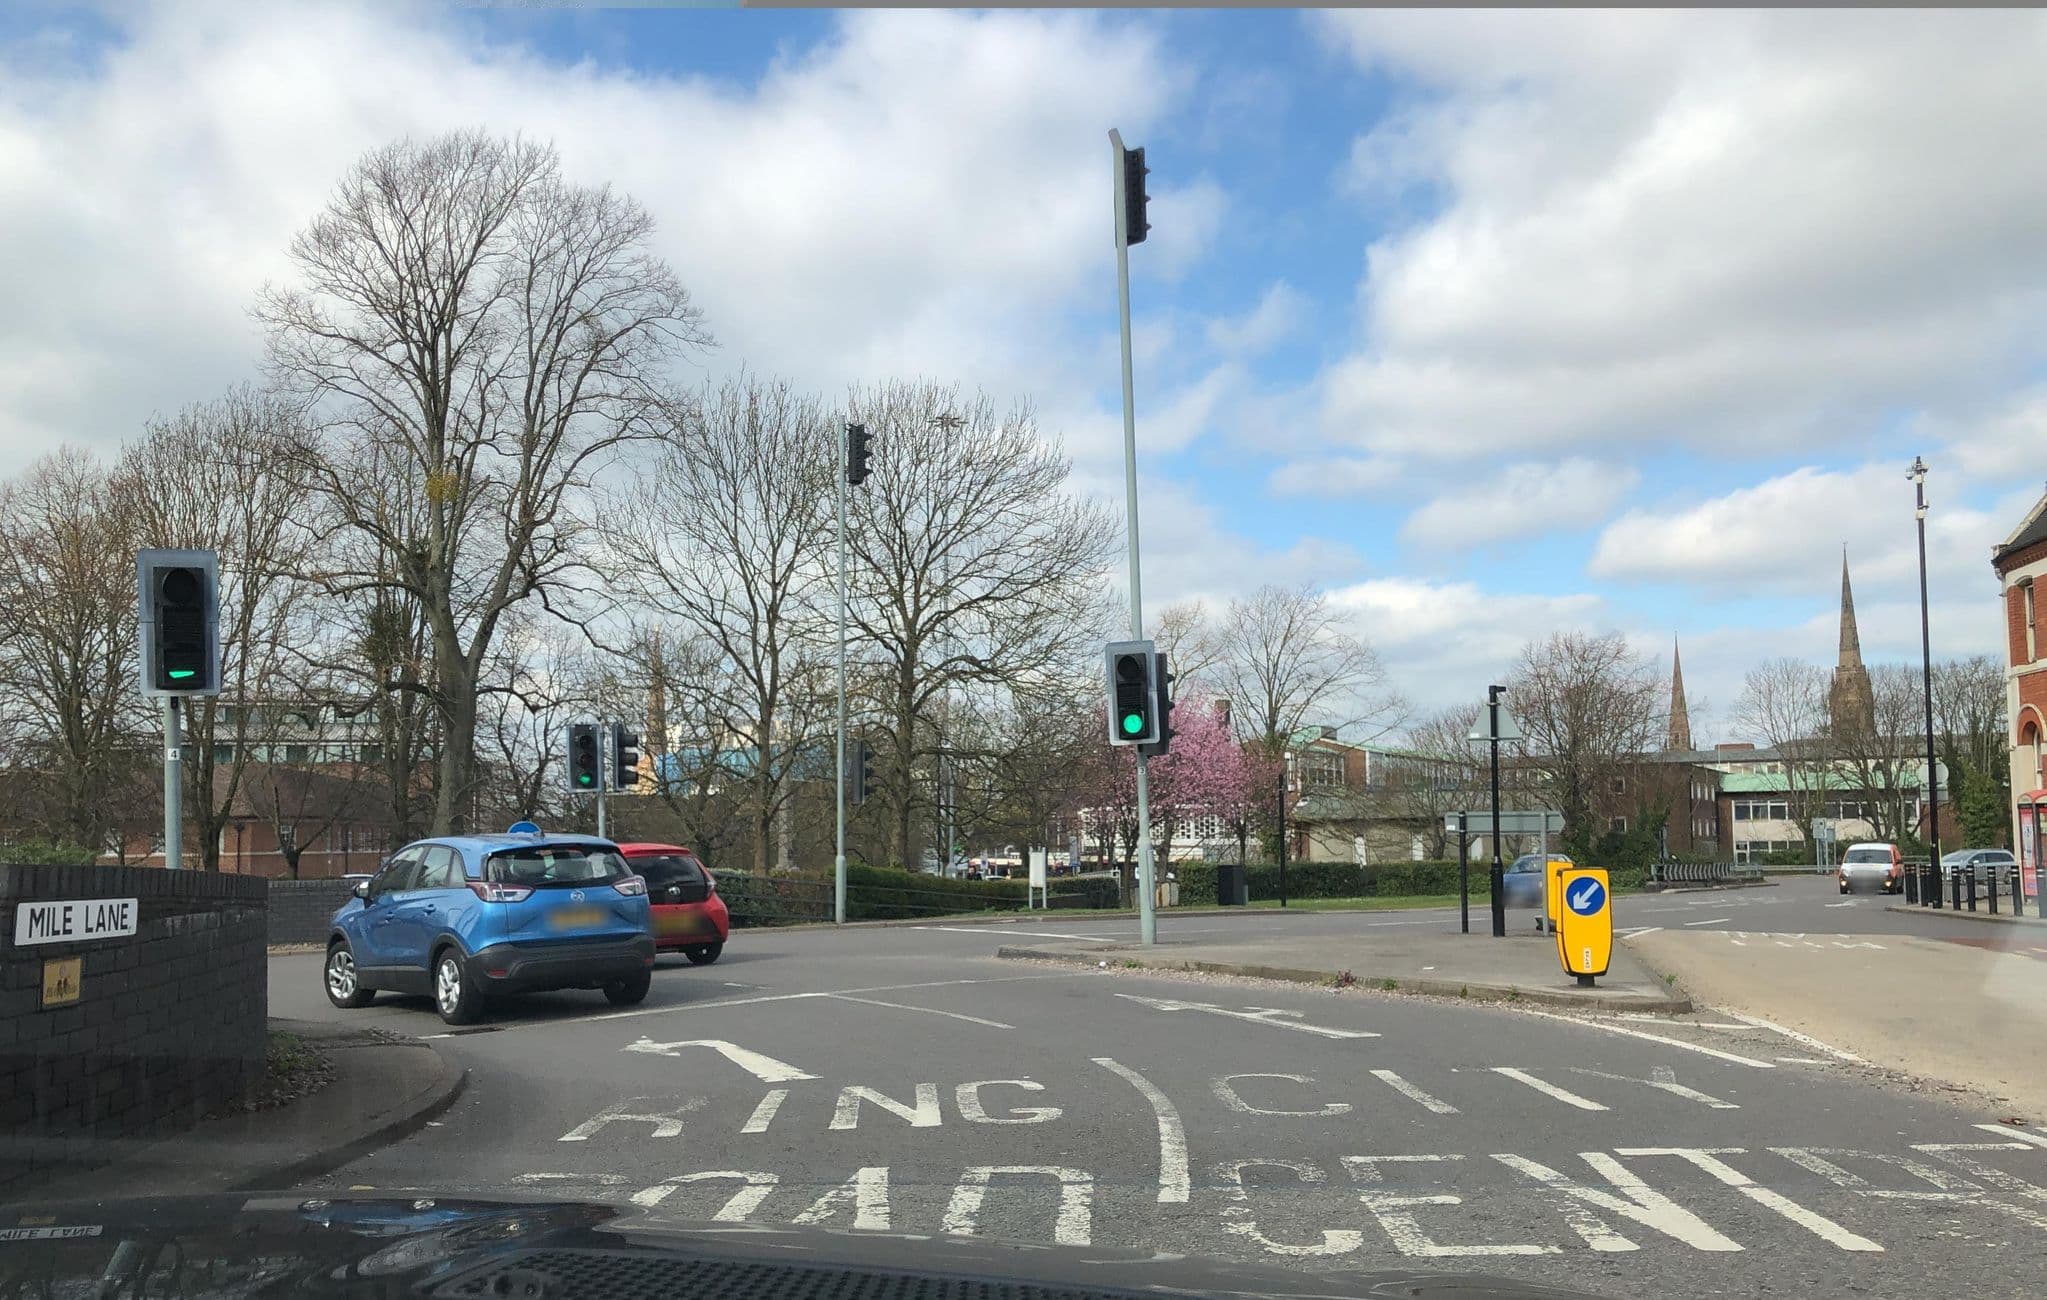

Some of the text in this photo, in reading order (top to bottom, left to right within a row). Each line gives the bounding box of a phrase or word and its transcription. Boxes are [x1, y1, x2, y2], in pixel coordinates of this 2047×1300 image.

[28, 903, 129, 938] MILE LANE
[557, 1079, 1063, 1141] RING
[1210, 1064, 1741, 1116] CITY
